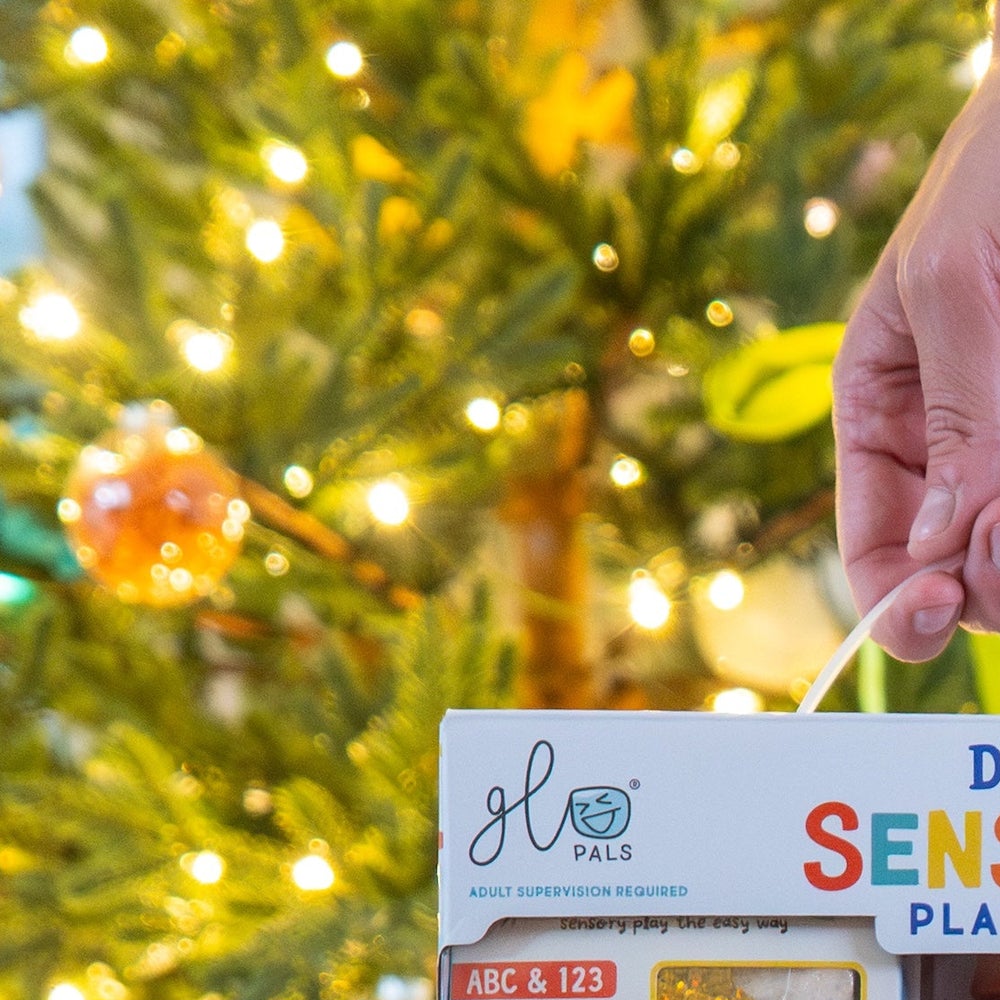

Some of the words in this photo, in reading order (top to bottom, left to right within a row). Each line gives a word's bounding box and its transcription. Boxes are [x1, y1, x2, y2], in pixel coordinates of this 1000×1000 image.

[574, 844, 633, 862] PALS
[469, 886, 512, 898] ADULT
[516, 886, 612, 898] SUPERVISION
[615, 886, 689, 898] REQUIRED
[560, 917, 626, 935] sensory
[712, 917, 750, 934] easy
[756, 918, 789, 934] way
[465, 968, 518, 995] ABC
[527, 968, 547, 994] &
[560, 966, 604, 994] 123
